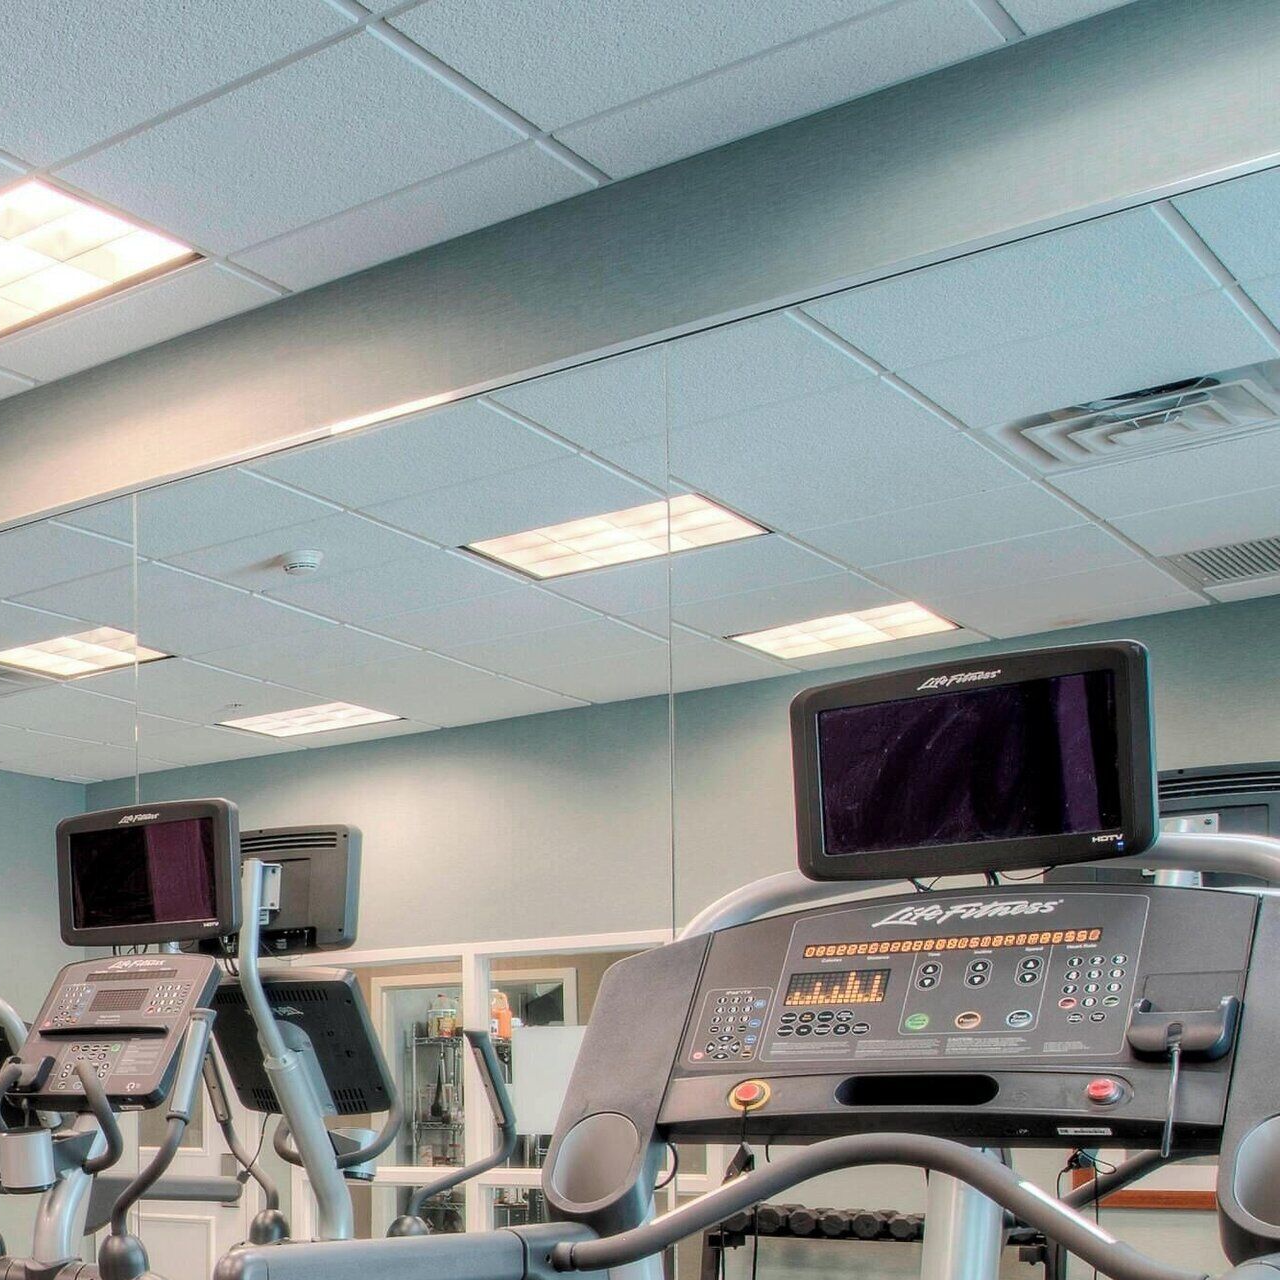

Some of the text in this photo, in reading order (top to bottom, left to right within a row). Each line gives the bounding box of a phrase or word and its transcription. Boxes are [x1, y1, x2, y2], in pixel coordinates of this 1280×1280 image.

[1092, 833, 1124, 843] HDTV
[871, 900, 1059, 928] Life Fitness
